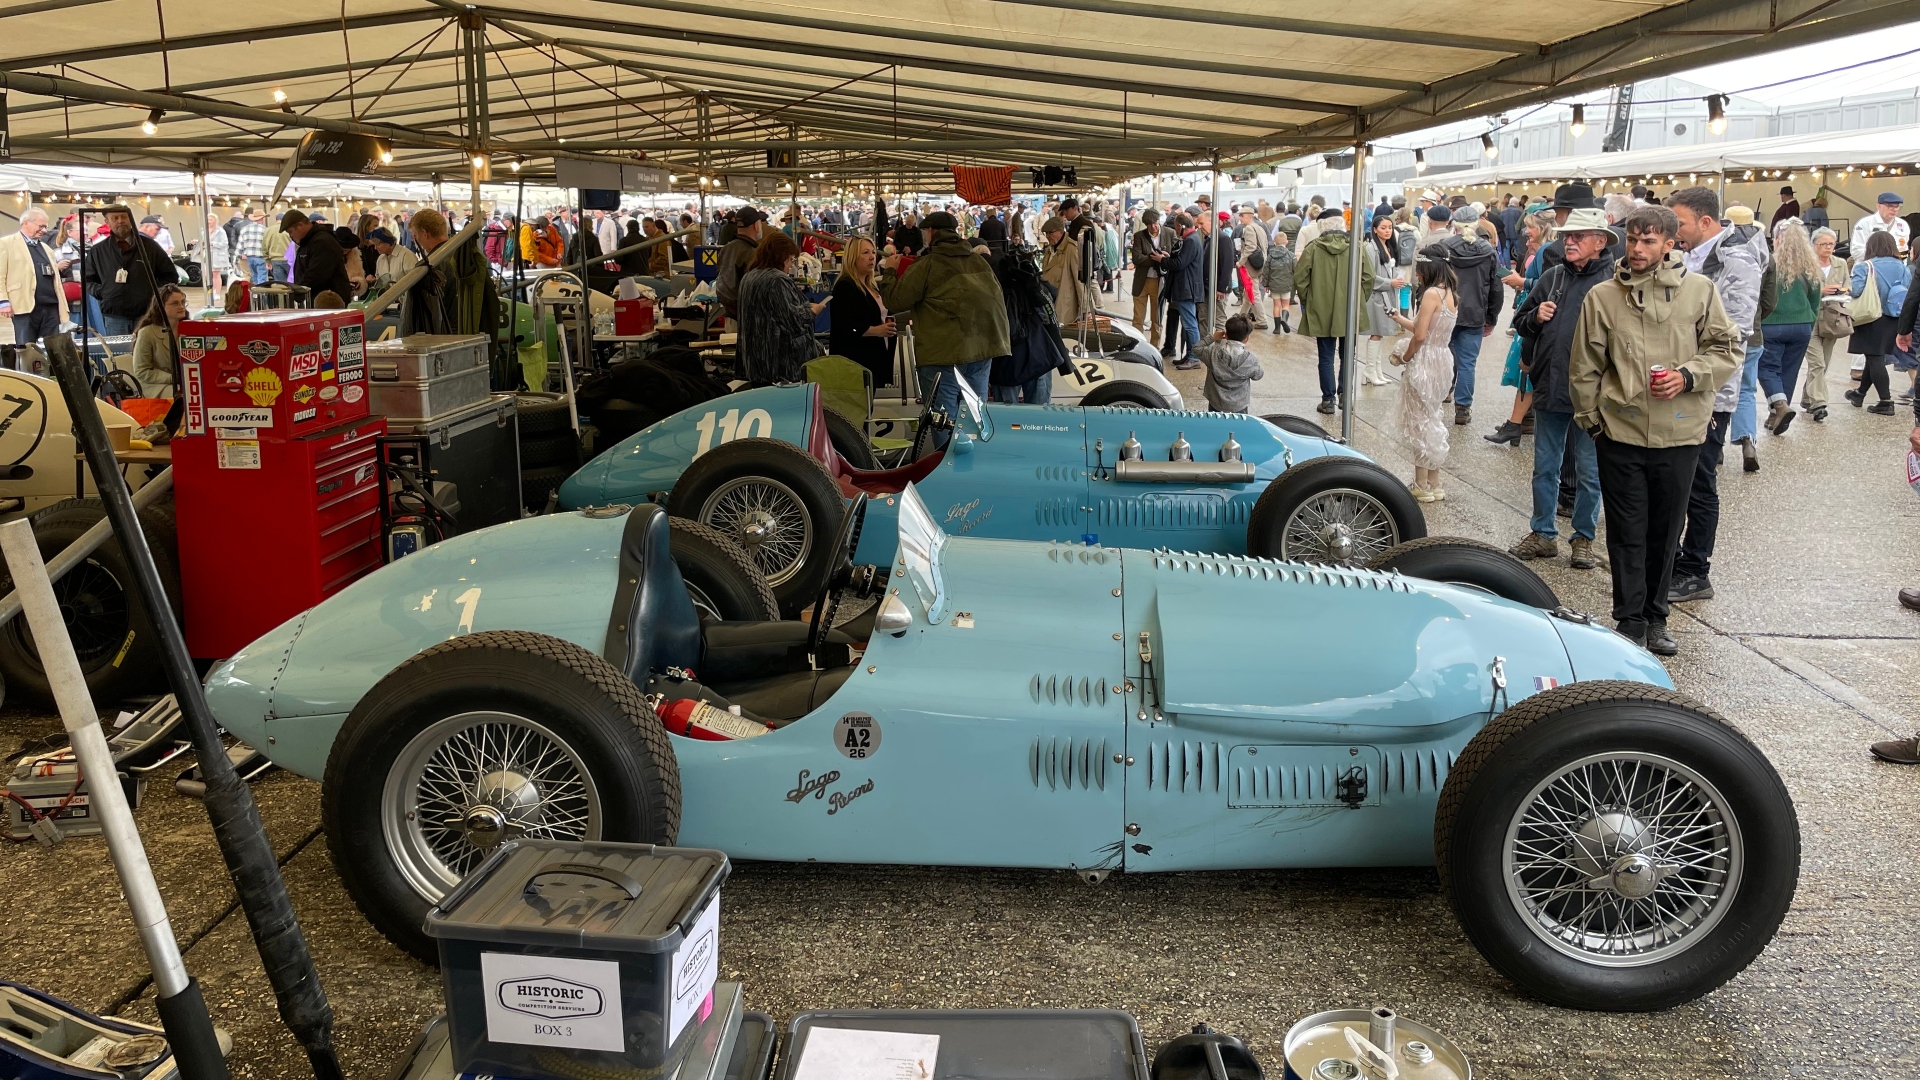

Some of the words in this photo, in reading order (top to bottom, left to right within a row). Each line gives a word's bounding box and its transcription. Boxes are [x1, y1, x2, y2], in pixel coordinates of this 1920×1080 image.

[183, 339, 201, 348] TAG
[182, 350, 203, 360] HEUER
[291, 353, 318, 372] MSD
[339, 350, 362, 362] Masters
[338, 370, 363, 383] FERODO
[1073, 363, 1106, 386] 12
[248, 381, 278, 391] SHELL
[212, 412, 268, 423] GOODYEAR
[691, 408, 773, 463] 110
[943, 498, 980, 524] Lago
[844, 728, 870, 747] A2
[849, 748, 866, 758] 26
[783, 769, 841, 803] Lago
[827, 778, 875, 815] Record
[683, 938, 709, 978] HISTORIC
[517, 985, 584, 1000] HISTORIC
[687, 991, 699, 1010] BOX
[698, 982, 704, 993] 3
[534, 1024, 563, 1036] BOX
[566, 1027, 573, 1037] 3
